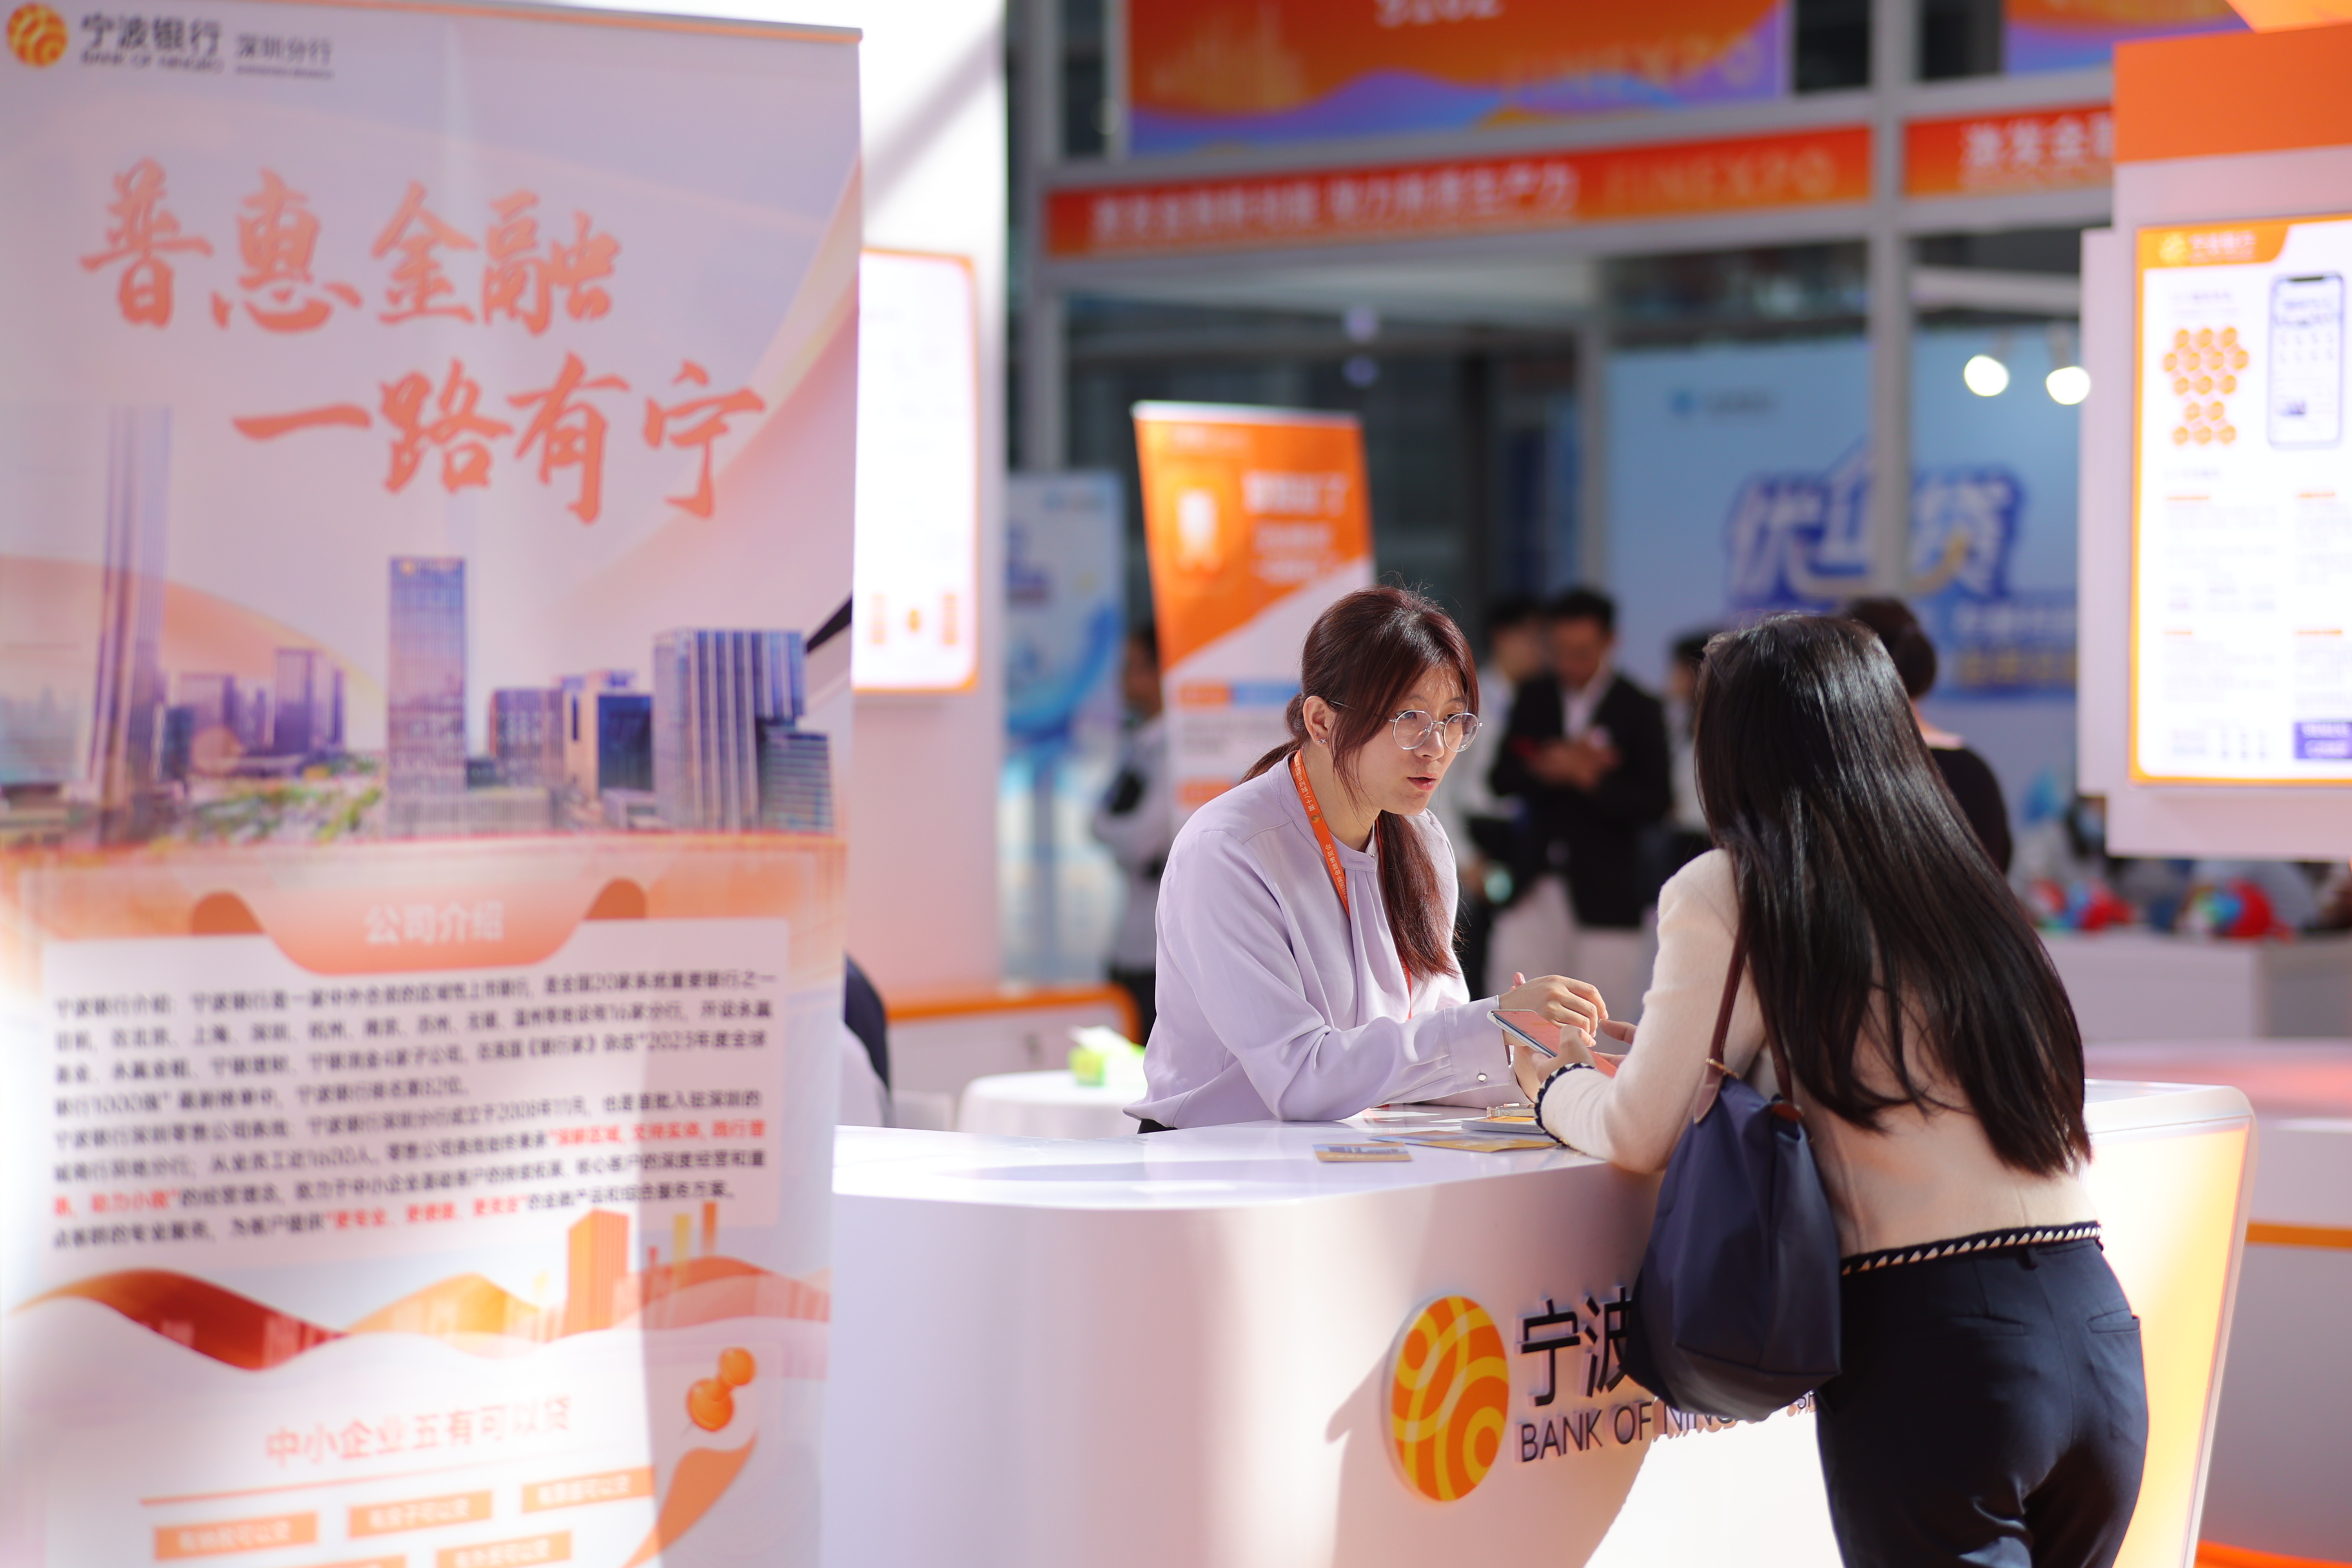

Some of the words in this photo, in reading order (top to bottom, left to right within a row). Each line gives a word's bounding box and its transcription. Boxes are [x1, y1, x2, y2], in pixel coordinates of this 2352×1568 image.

[81, 13, 220, 57] 宁波银行
[236, 35, 333, 64] 深圳分行
[80, 157, 622, 337] 普惠金融
[233, 351, 766, 526] 一路有宁
[365, 901, 504, 945] 公司介绍
[265, 1393, 571, 1467] 中小企业五有可以贷
[1521, 1409, 1603, 1462] BANK
[1614, 1401, 1652, 1445] OF
